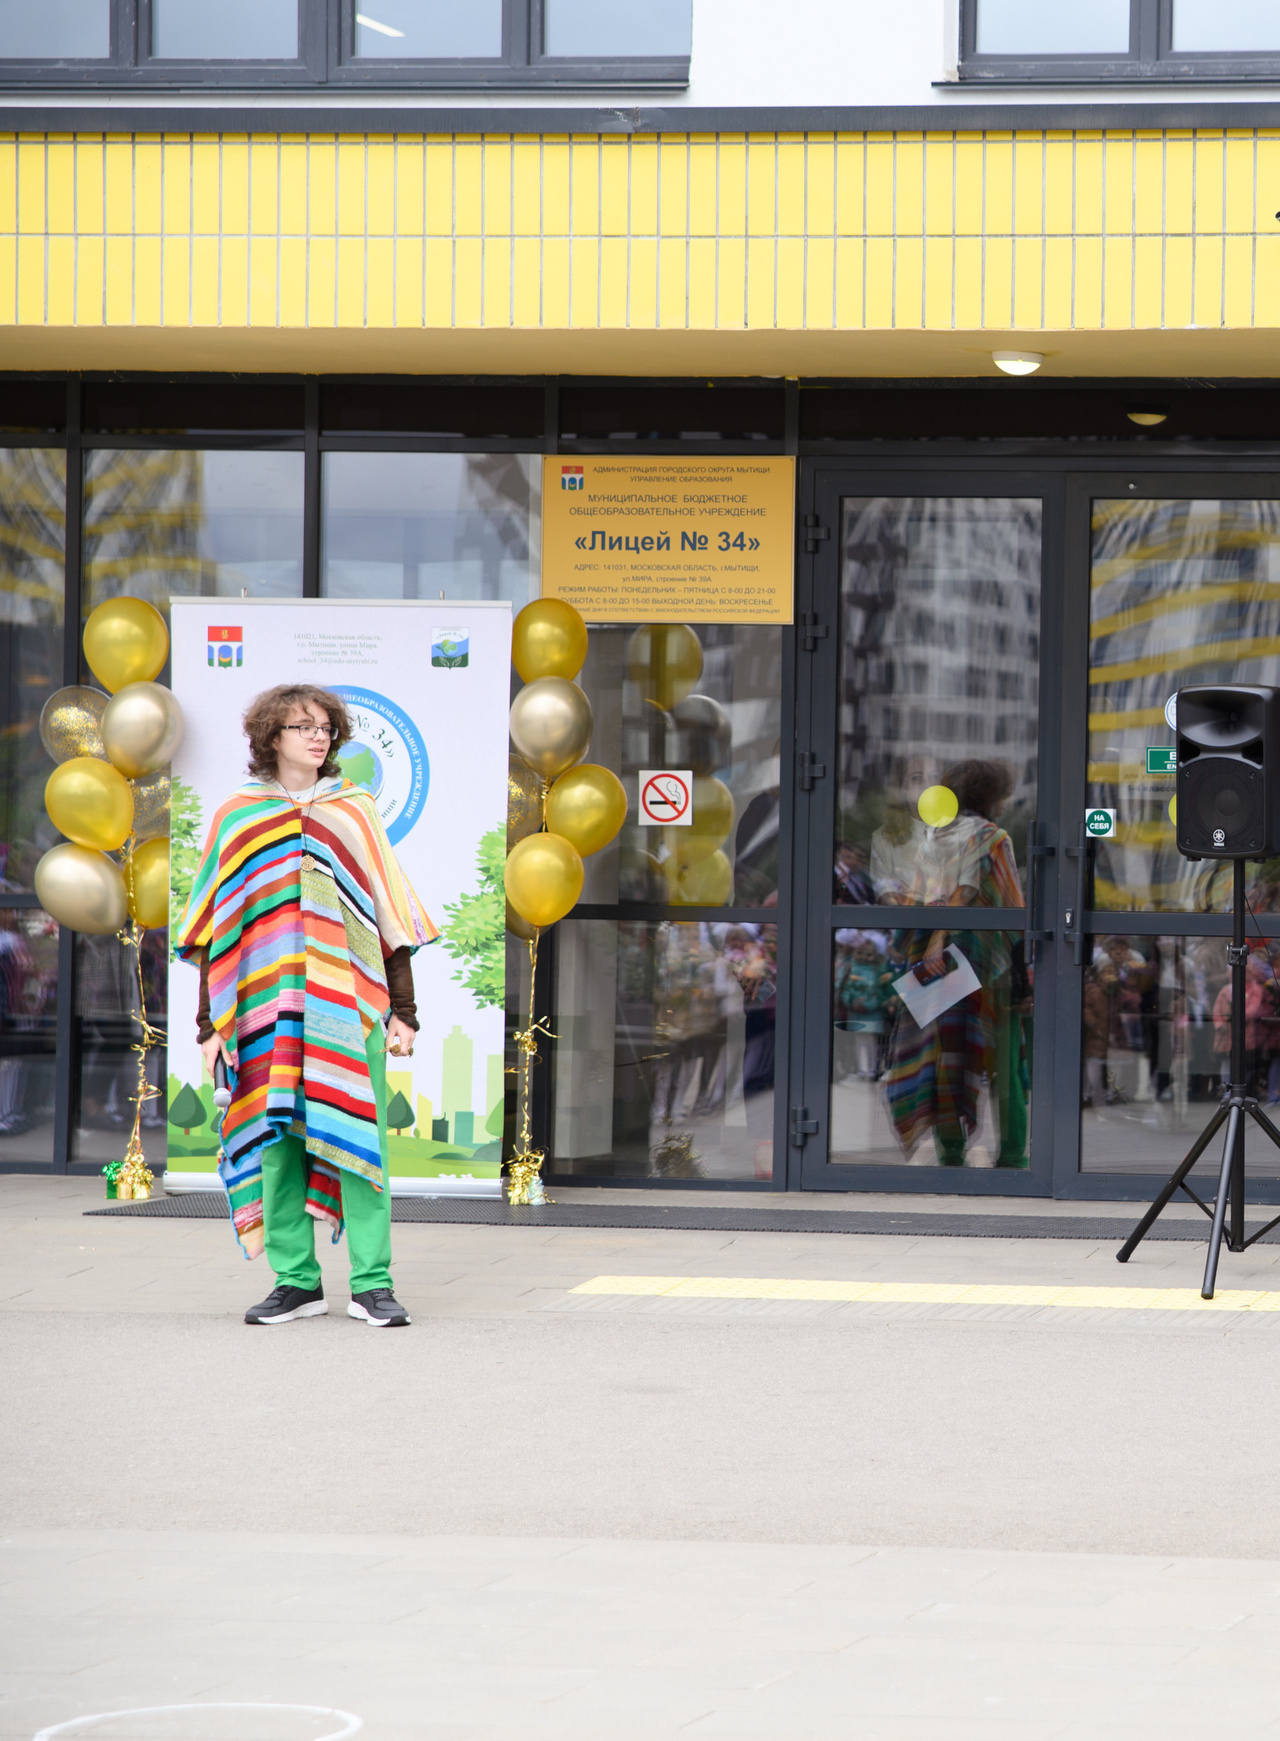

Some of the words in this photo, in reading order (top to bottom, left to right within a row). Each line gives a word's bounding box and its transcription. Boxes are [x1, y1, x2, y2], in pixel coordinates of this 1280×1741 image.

[592, 466, 657, 474] АДМИНИСТРАЦИЯ
[658, 466, 706, 474] ГОРОДСКОГО
[708, 466, 735, 474] ОКРУГА
[588, 494, 678, 505] МУНИЦИПАЛЬНОЕ
[683, 494, 748, 505] БЮДЖЕТНОЕ
[569, 507, 696, 517] ОБЩЕОБРАЗОВАТЕЛЬНОЕ
[699, 507, 767, 517] УЧРЕЖДЕНИЕ
[574, 530, 671, 554] «Лицей
[680, 531, 709, 551] №
[717, 531, 761, 552] 34»
[574, 563, 600, 571] АДРЕС:
[683, 564, 718, 572] ОБЛАСТЬ,
[621, 586, 676, 594] ПОНЕДЕЛЬНИК
[683, 587, 720, 595] ПЯТНИЦА
[744, 587, 755, 595] ДО
[619, 597, 630, 605] ДО
[651, 596, 694, 605] ВЫХОДНОЙ
[353, 714, 370, 732] №
[372, 728, 395, 758] 34»
[340, 692, 420, 758] ЩЕОБРАЗОВАТЕЛЬНОЕ
[403, 757, 423, 820] УЧРЕЖДЕНИЕ
[1089, 822, 1109, 830] СЕБЯ
